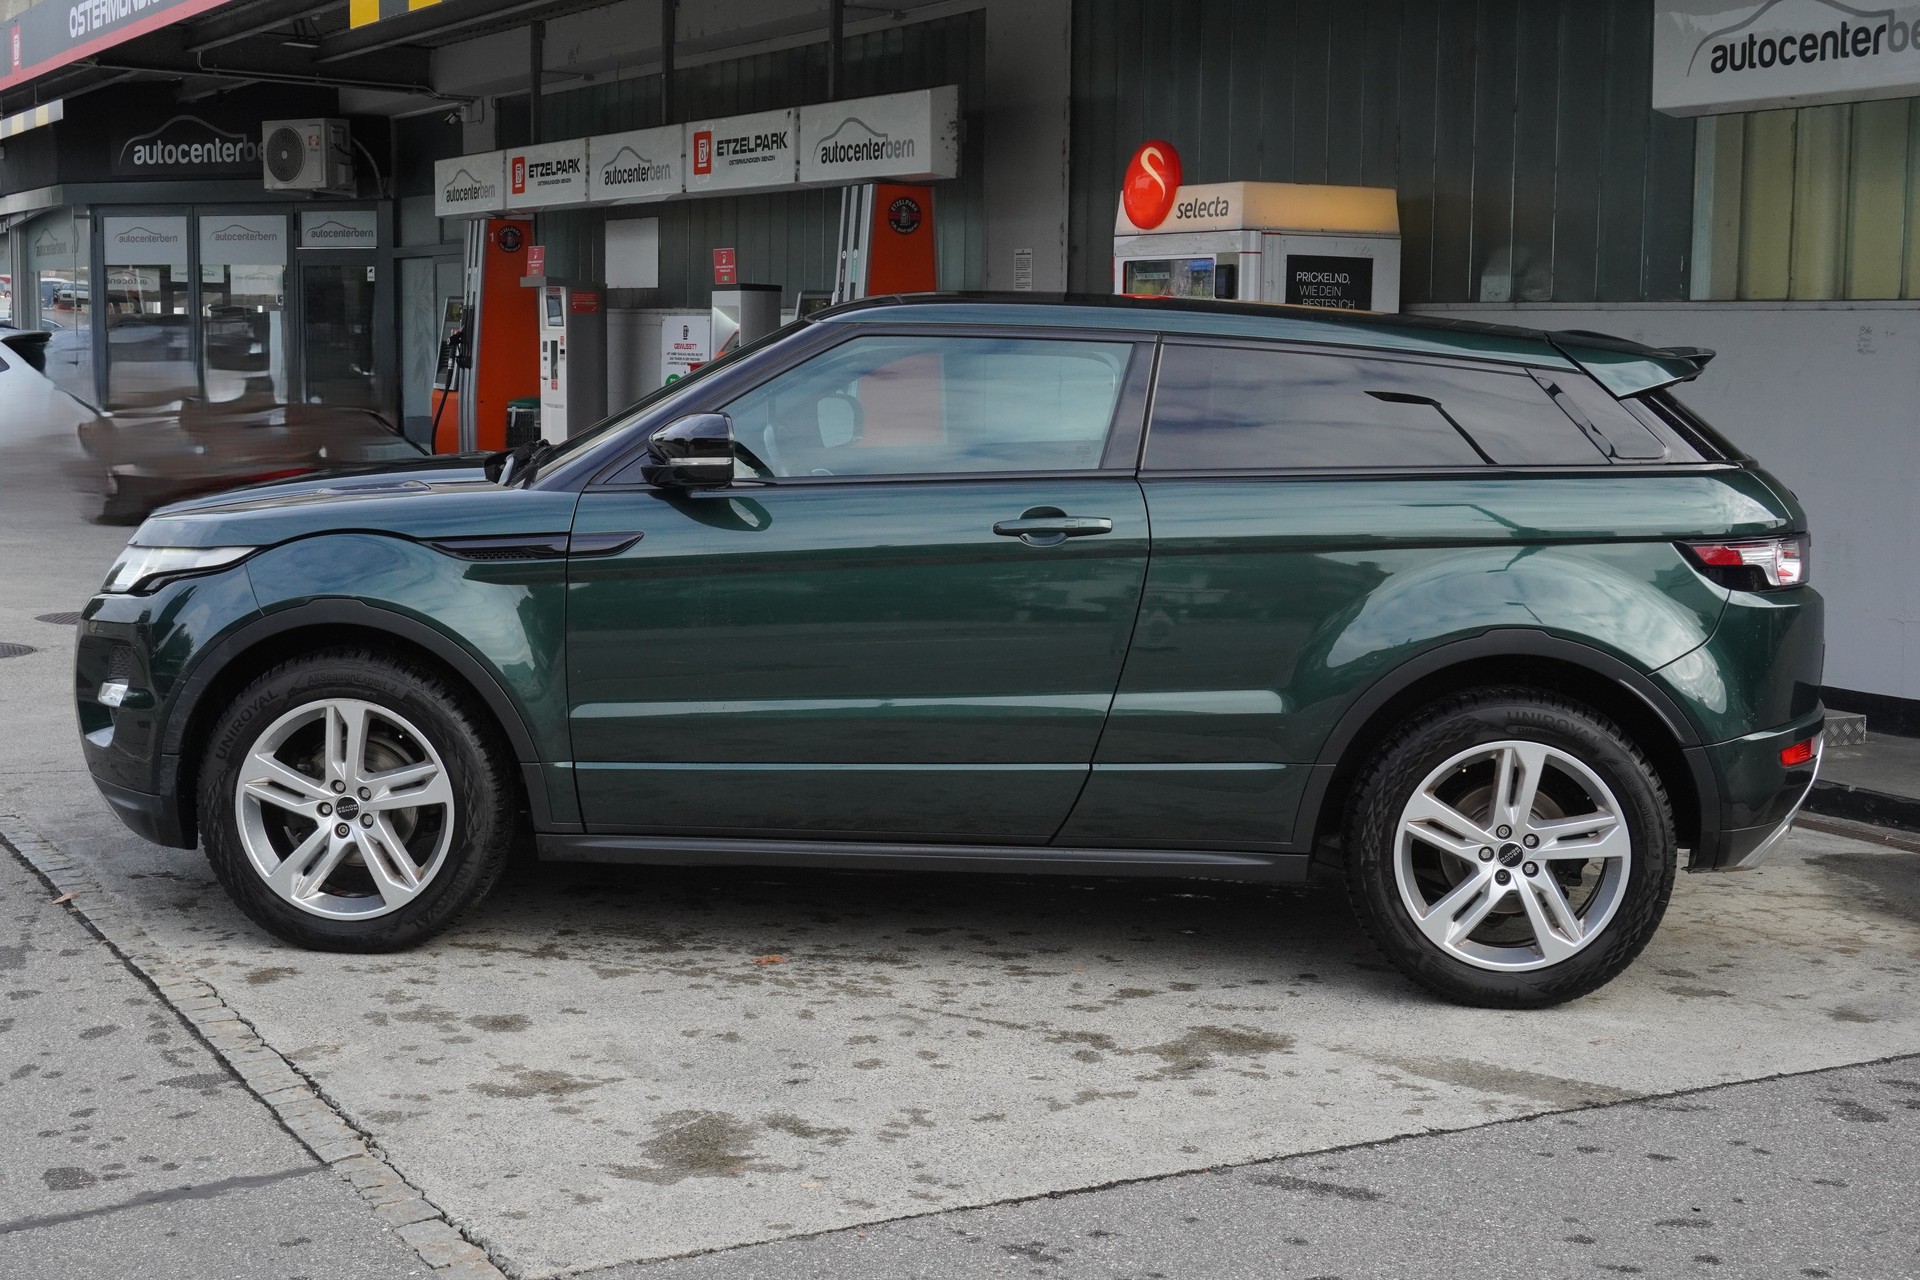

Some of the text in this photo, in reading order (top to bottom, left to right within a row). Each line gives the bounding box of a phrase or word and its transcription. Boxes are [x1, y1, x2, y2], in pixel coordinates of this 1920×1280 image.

[716, 131, 788, 156] ETZELPARK
[821, 137, 915, 164] autocenterbern
[528, 158, 581, 178] ETZELPARK
[604, 160, 671, 185] autocenterbern
[446, 182, 496, 203] autocenterbern
[1175, 196, 1229, 220] selecta
[118, 233, 178, 243] autocenterbern
[215, 231, 277, 241] autocenterbern
[311, 228, 373, 238] autocenterbern
[489, 232, 495, 242] 1
[1296, 271, 1351, 285] PRICKELND,
[1299, 285, 1342, 297] WIE DEIN
[215, 688, 280, 761] UNIROYAL
